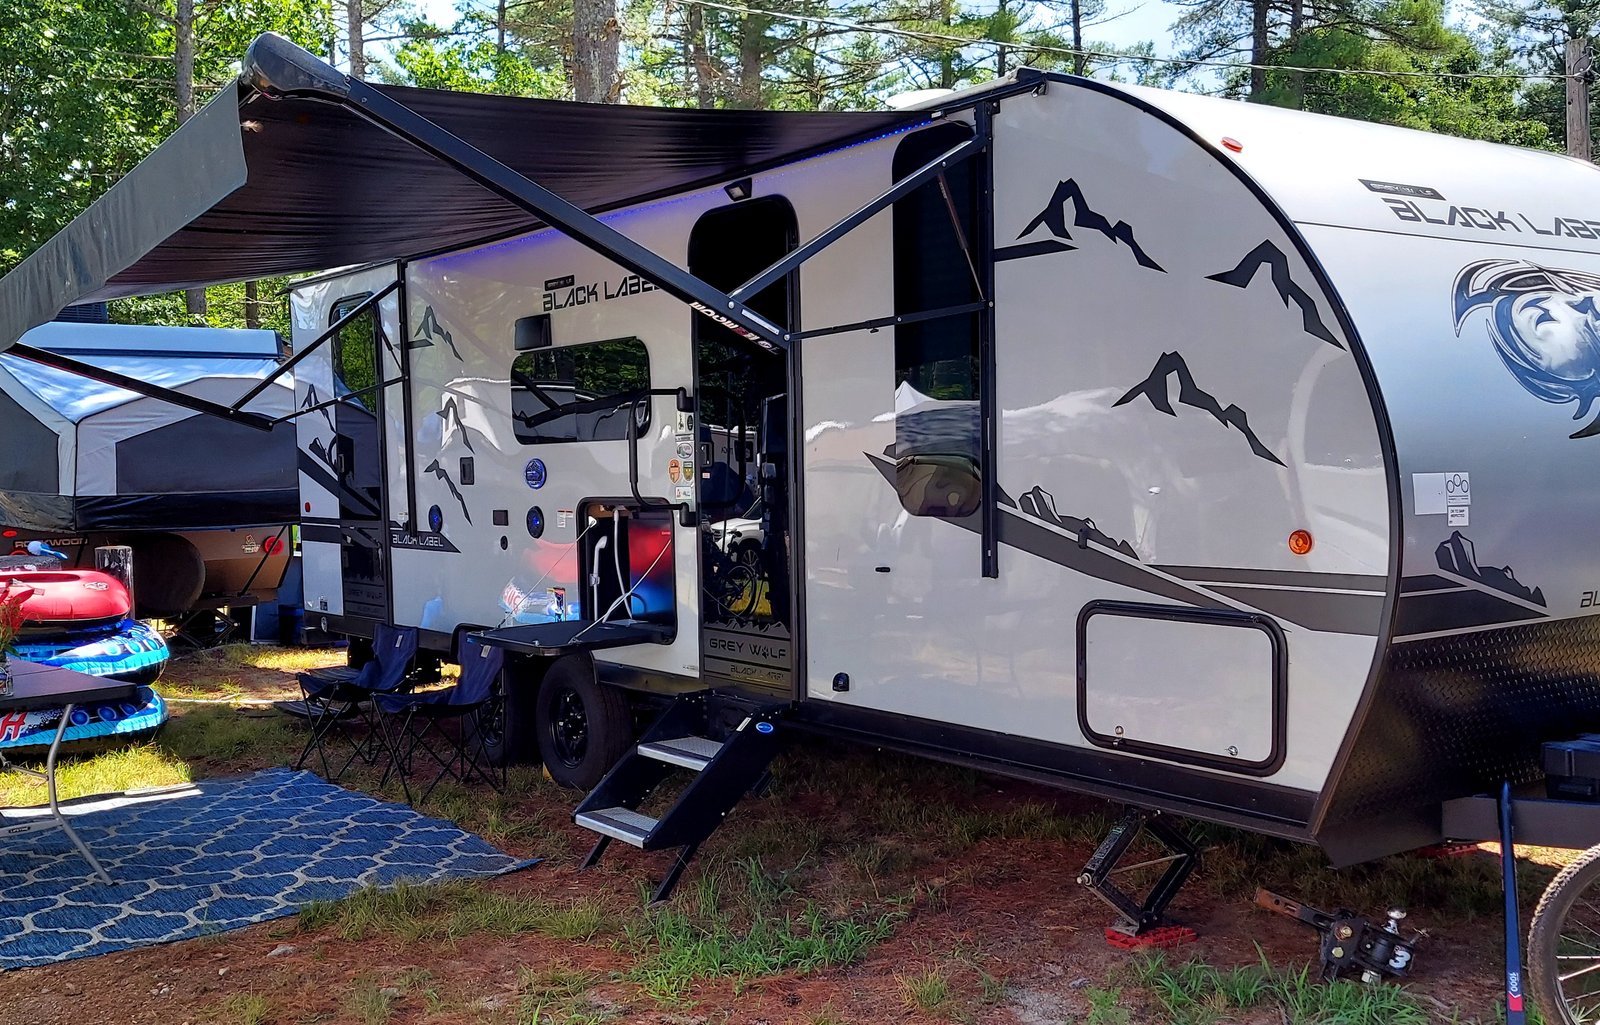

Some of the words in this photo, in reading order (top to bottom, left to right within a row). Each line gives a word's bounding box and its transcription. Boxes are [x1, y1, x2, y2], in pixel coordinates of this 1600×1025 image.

[1381, 197, 1522, 232] BLACK
[543, 283, 598, 312] BLACK
[604, 274, 660, 300] LABE
[15, 537, 88, 548] ROKWOOD
[392, 534, 417, 545] BLACK
[419, 536, 444, 547] LABEL
[709, 638, 744, 653] GREY
[1388, 950, 1411, 970] 3
[1508, 971, 1519, 992] 1000
